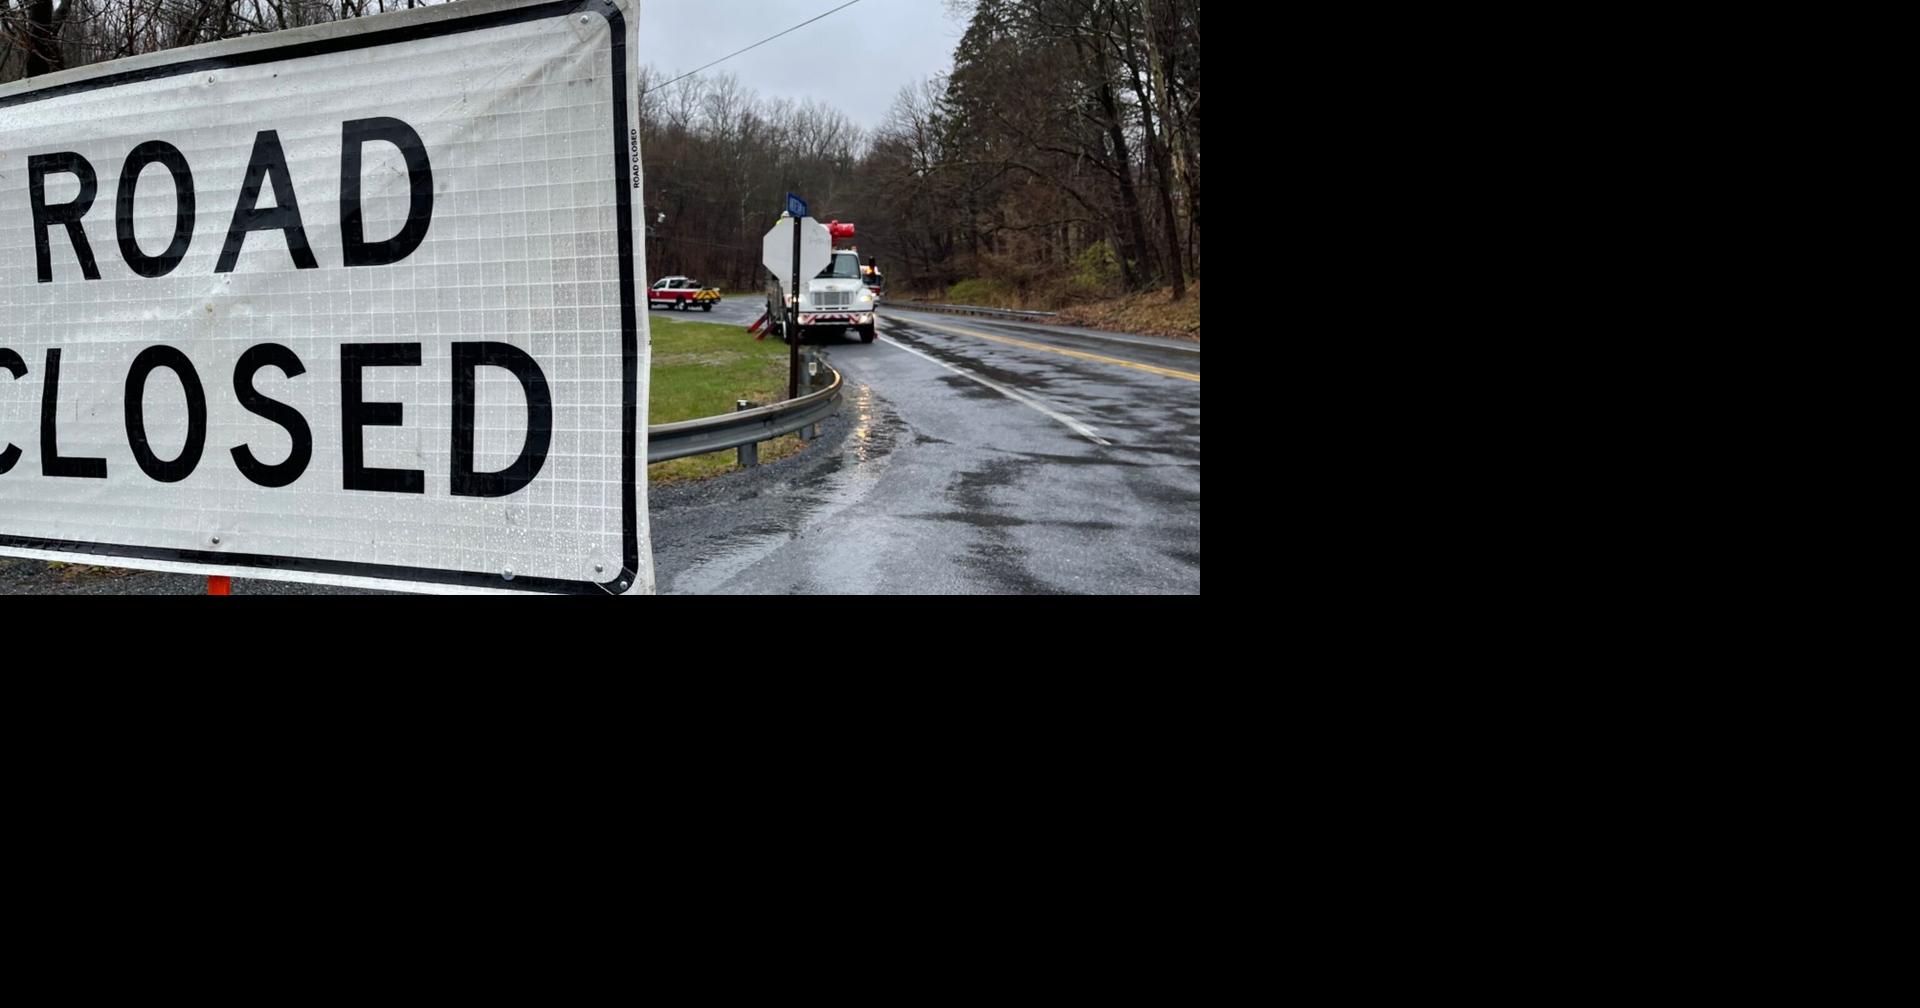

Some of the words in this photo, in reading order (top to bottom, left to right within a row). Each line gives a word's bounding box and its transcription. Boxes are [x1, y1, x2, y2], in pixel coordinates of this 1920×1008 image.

[631, 129, 639, 163] CLOSED
[632, 164, 640, 189] ROAD
[27, 116, 434, 284] ROAD
